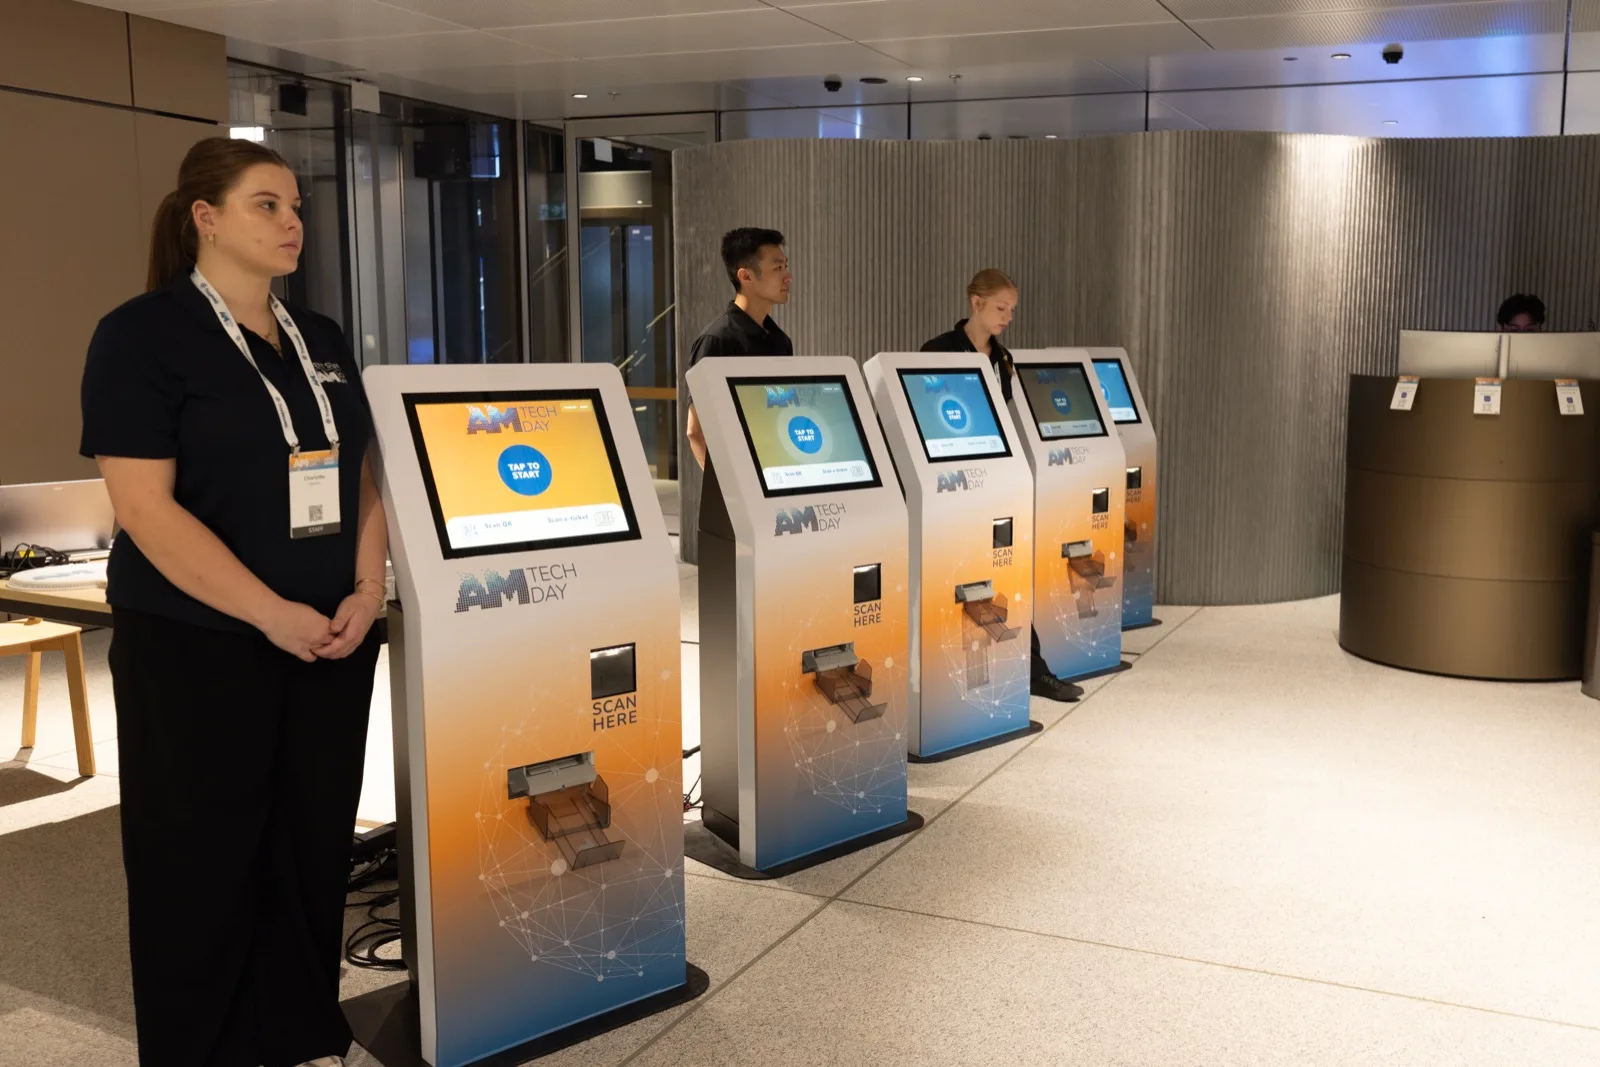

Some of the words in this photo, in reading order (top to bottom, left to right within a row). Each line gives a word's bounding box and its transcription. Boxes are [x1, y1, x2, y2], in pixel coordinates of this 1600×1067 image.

[466, 404, 524, 435] AM
[519, 405, 558, 419] TECH
[522, 420, 551, 433] DAY
[1048, 448, 1073, 466] AM
[508, 463, 526, 472] TAP
[527, 461, 540, 470] TO
[512, 471, 540, 480] START
[937, 470, 968, 493] AM
[964, 467, 988, 478] TECH
[967, 479, 985, 490] DAY
[774, 506, 819, 536] AM
[814, 502, 847, 517] TECH
[818, 517, 841, 532] DAY
[1092, 514, 1109, 522] SCAN
[1092, 521, 1108, 530] HERE
[992, 548, 1013, 559] SCAN
[992, 556, 1013, 568] HERE
[454, 568, 531, 614] AM
[526, 562, 578, 583] TECH
[530, 583, 568, 604] DAY
[854, 602, 882, 616] SCAN
[854, 613, 882, 628] HERE
[592, 694, 637, 716] SCAN
[593, 710, 637, 732] HERE
